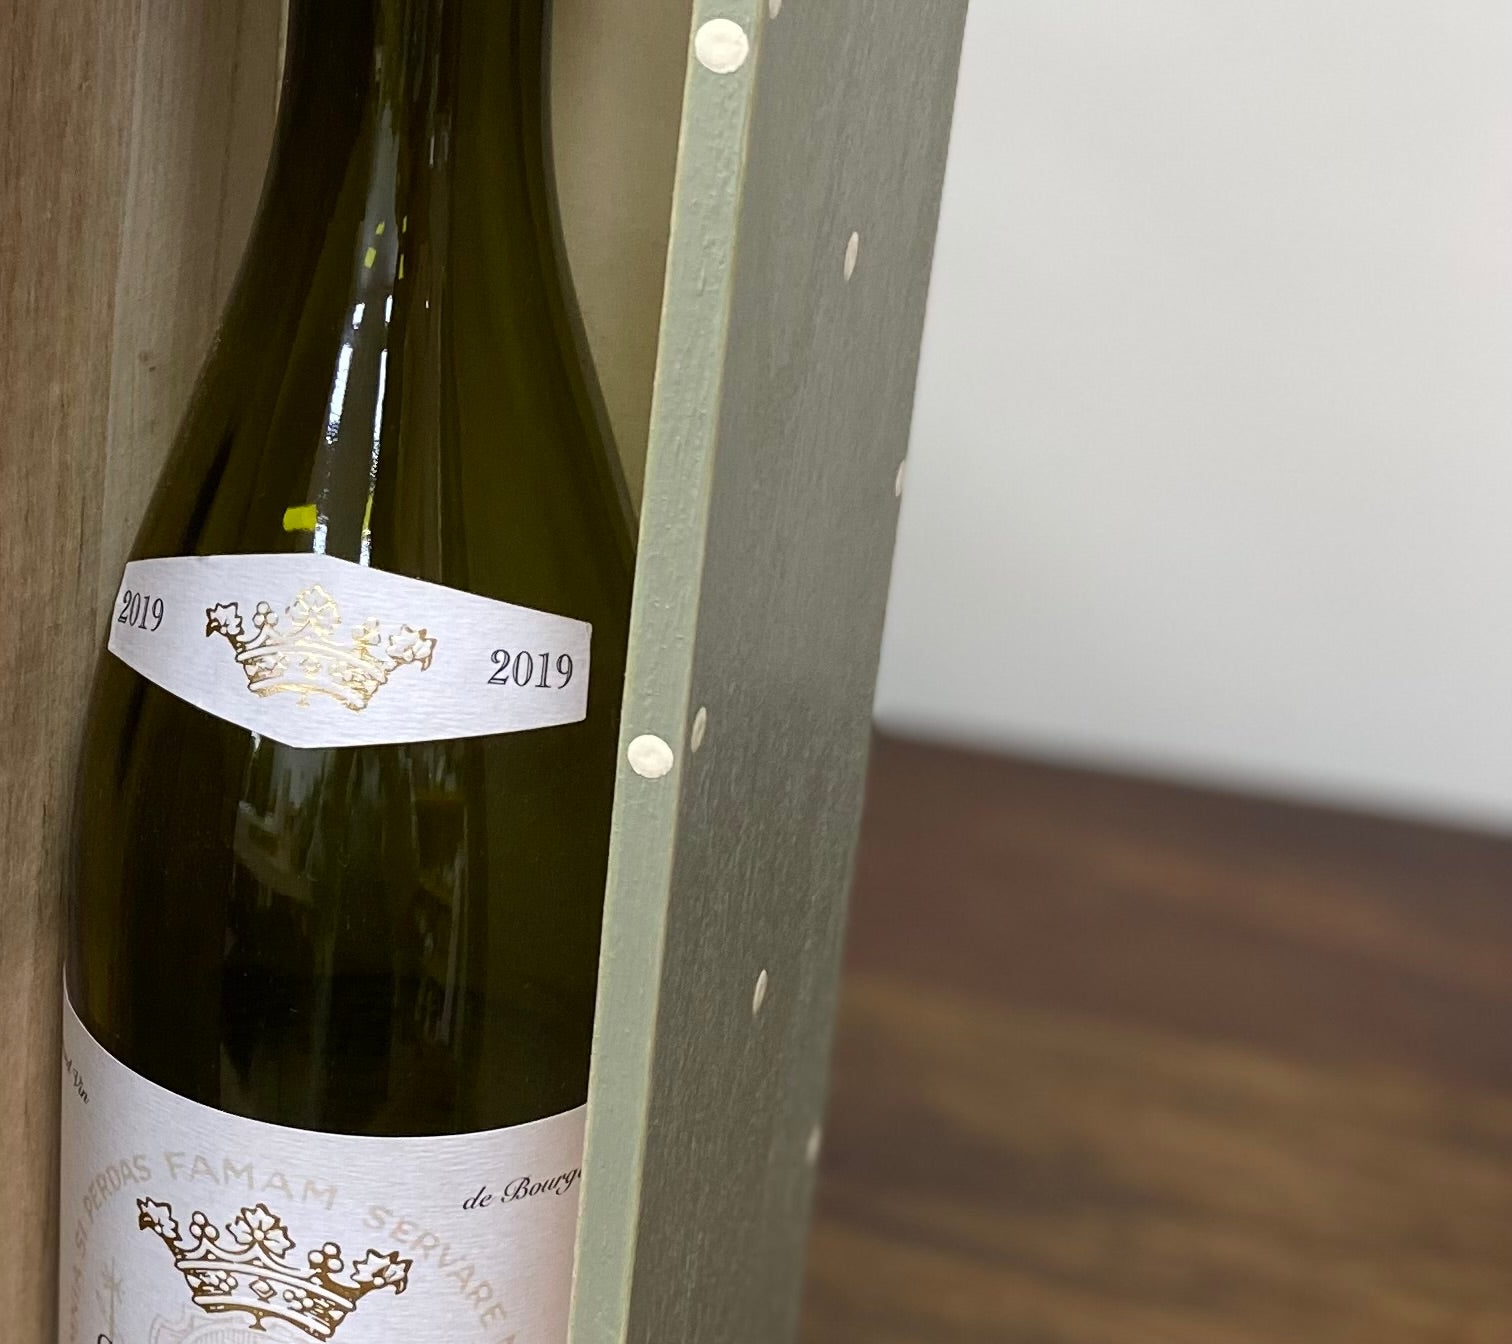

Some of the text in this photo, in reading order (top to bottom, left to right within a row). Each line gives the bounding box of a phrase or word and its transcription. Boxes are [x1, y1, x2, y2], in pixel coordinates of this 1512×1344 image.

[117, 589, 165, 632] 2019
[488, 649, 574, 688] 2019
[462, 1186, 493, 1211] de
[163, 1151, 339, 1212] FAMAM
[363, 1205, 507, 1330] SERVARE
